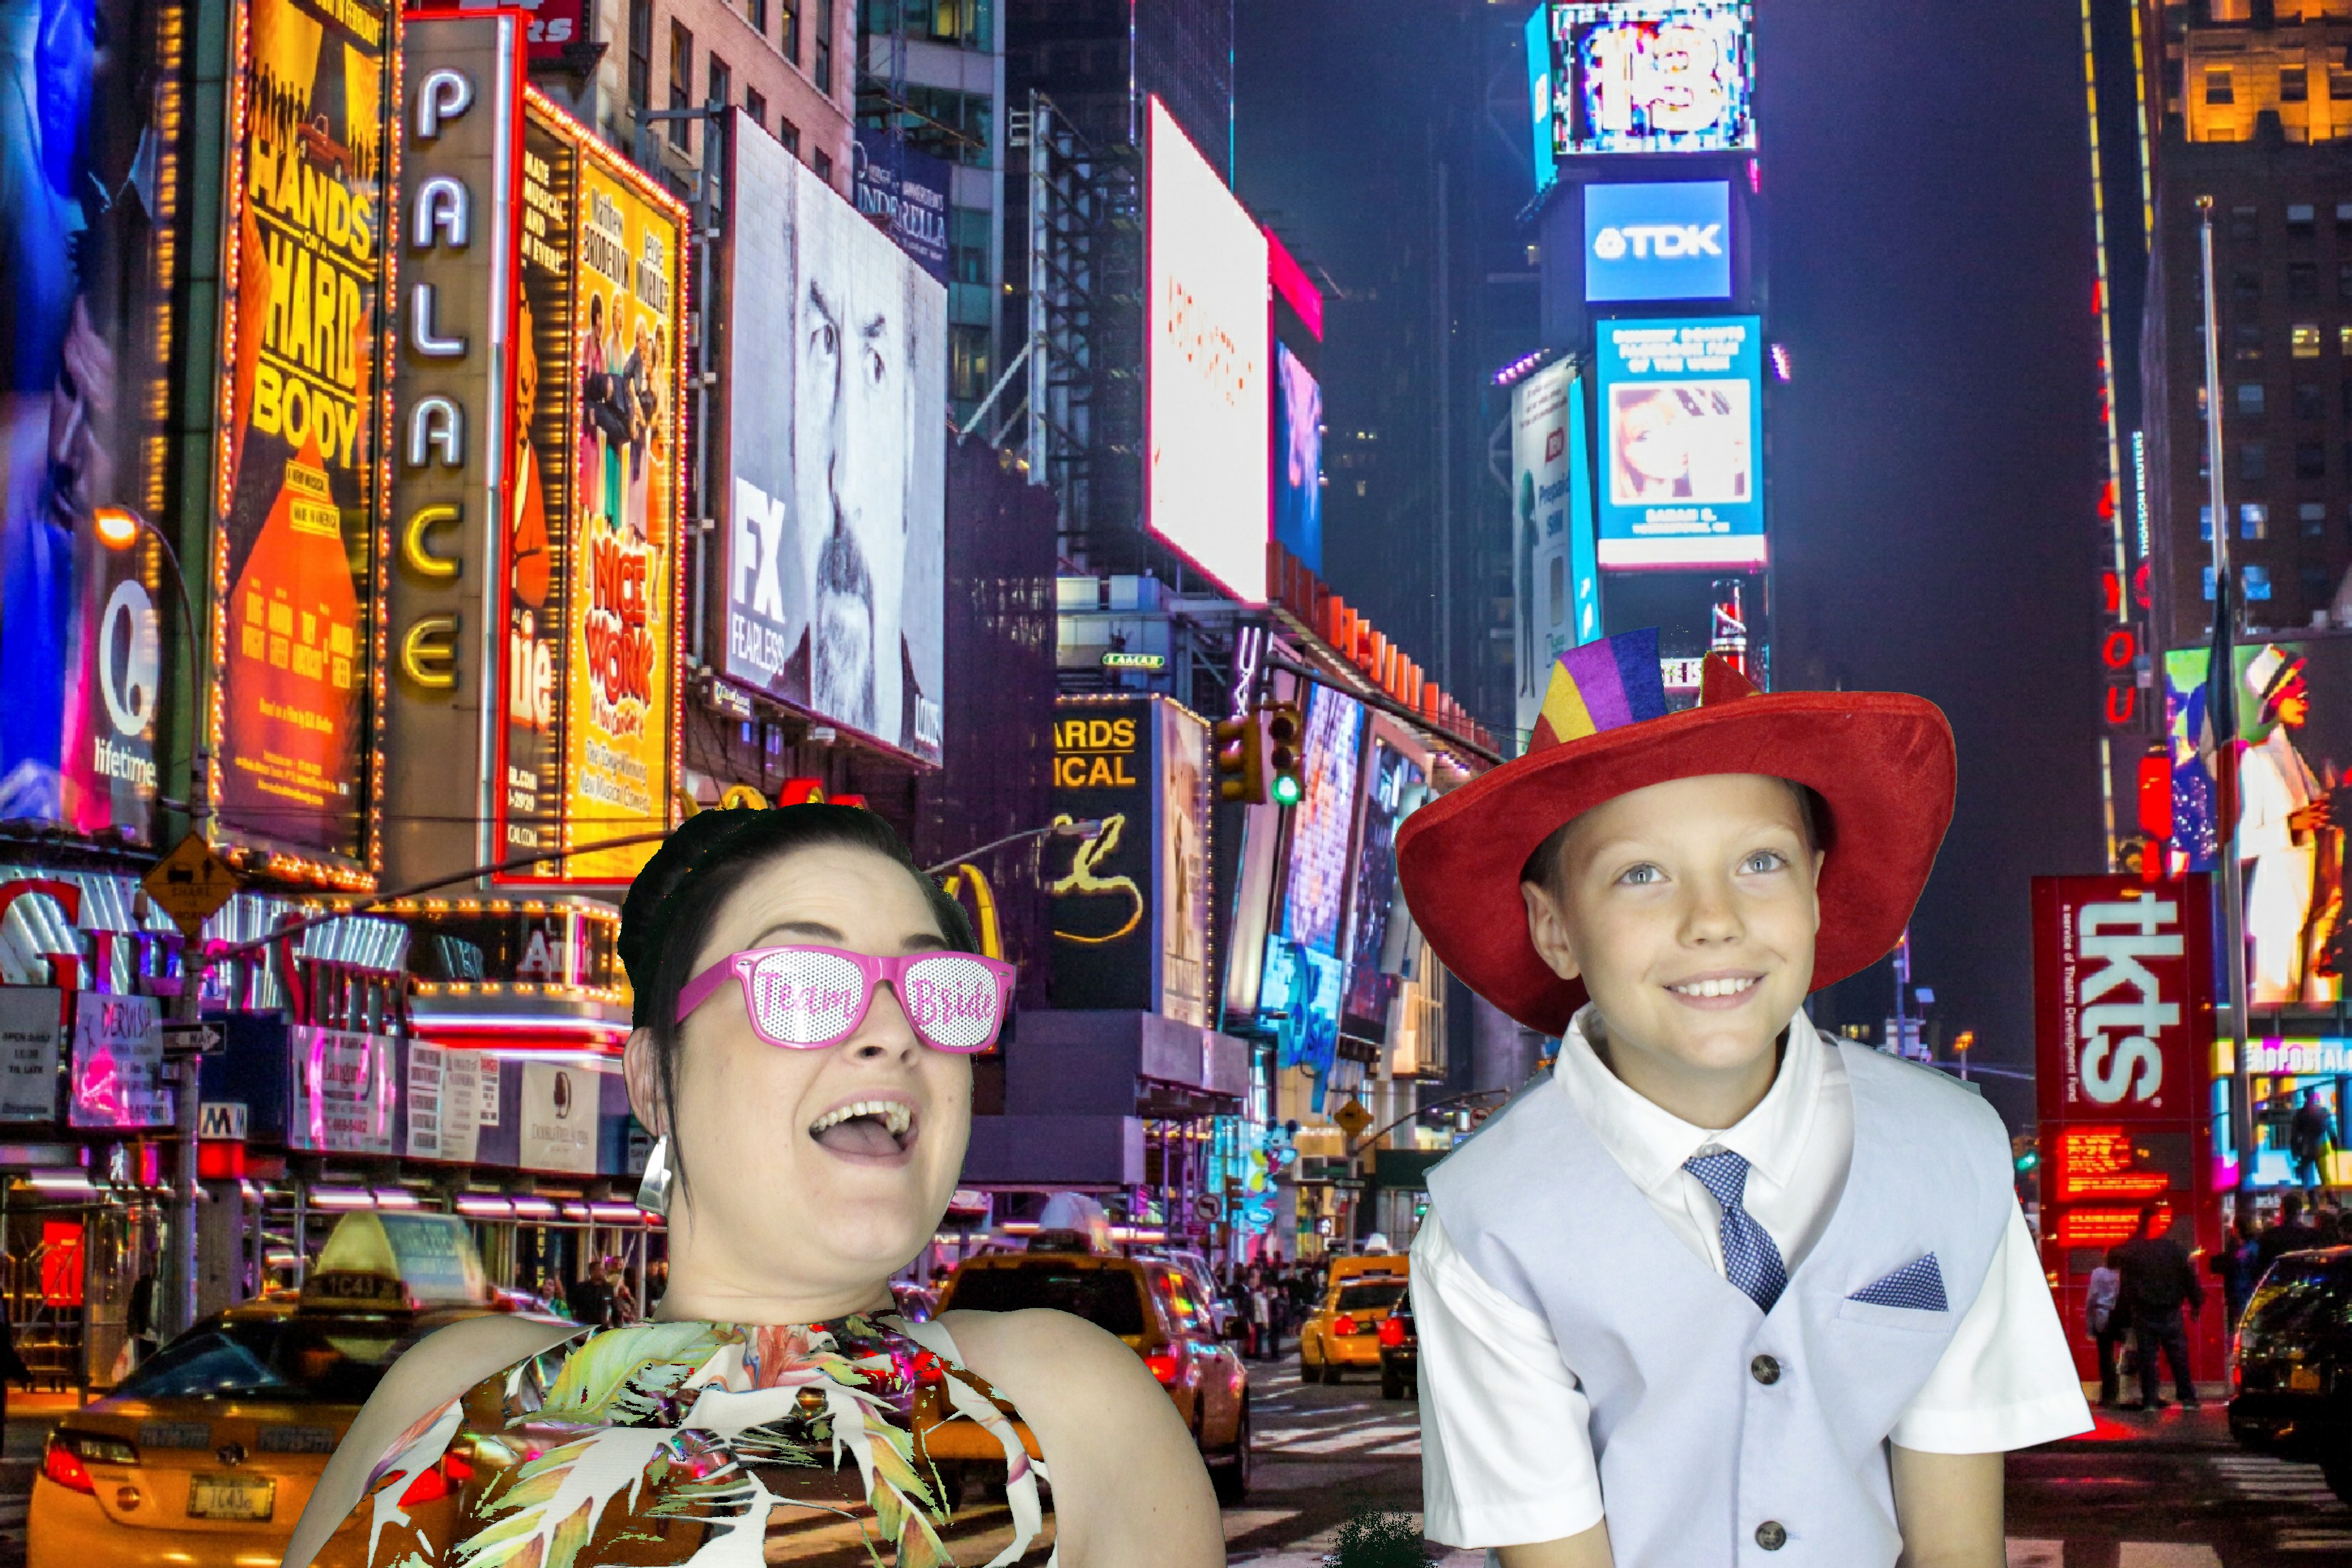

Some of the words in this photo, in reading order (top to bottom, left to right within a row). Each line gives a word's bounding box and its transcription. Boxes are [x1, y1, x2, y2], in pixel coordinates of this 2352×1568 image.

[249, 136, 370, 260] HANDS
[525, 206, 546, 238] AND
[1622, 224, 1722, 258] TDK
[265, 231, 361, 389] HARD
[252, 361, 359, 468] BODY
[402, 67, 474, 687] PALACE
[591, 535, 647, 627] NICE
[733, 474, 786, 624] FX
[585, 608, 655, 710] WORK
[732, 612, 785, 676] FEARLESS
[2063, 913, 2072, 950] service
[755, 973, 860, 1020] Team
[913, 979, 998, 1026] Bride
[2064, 1007, 2076, 1074] Development
[2079, 892, 2184, 1104] tkts
[2068, 1077, 2079, 1103] Fund
